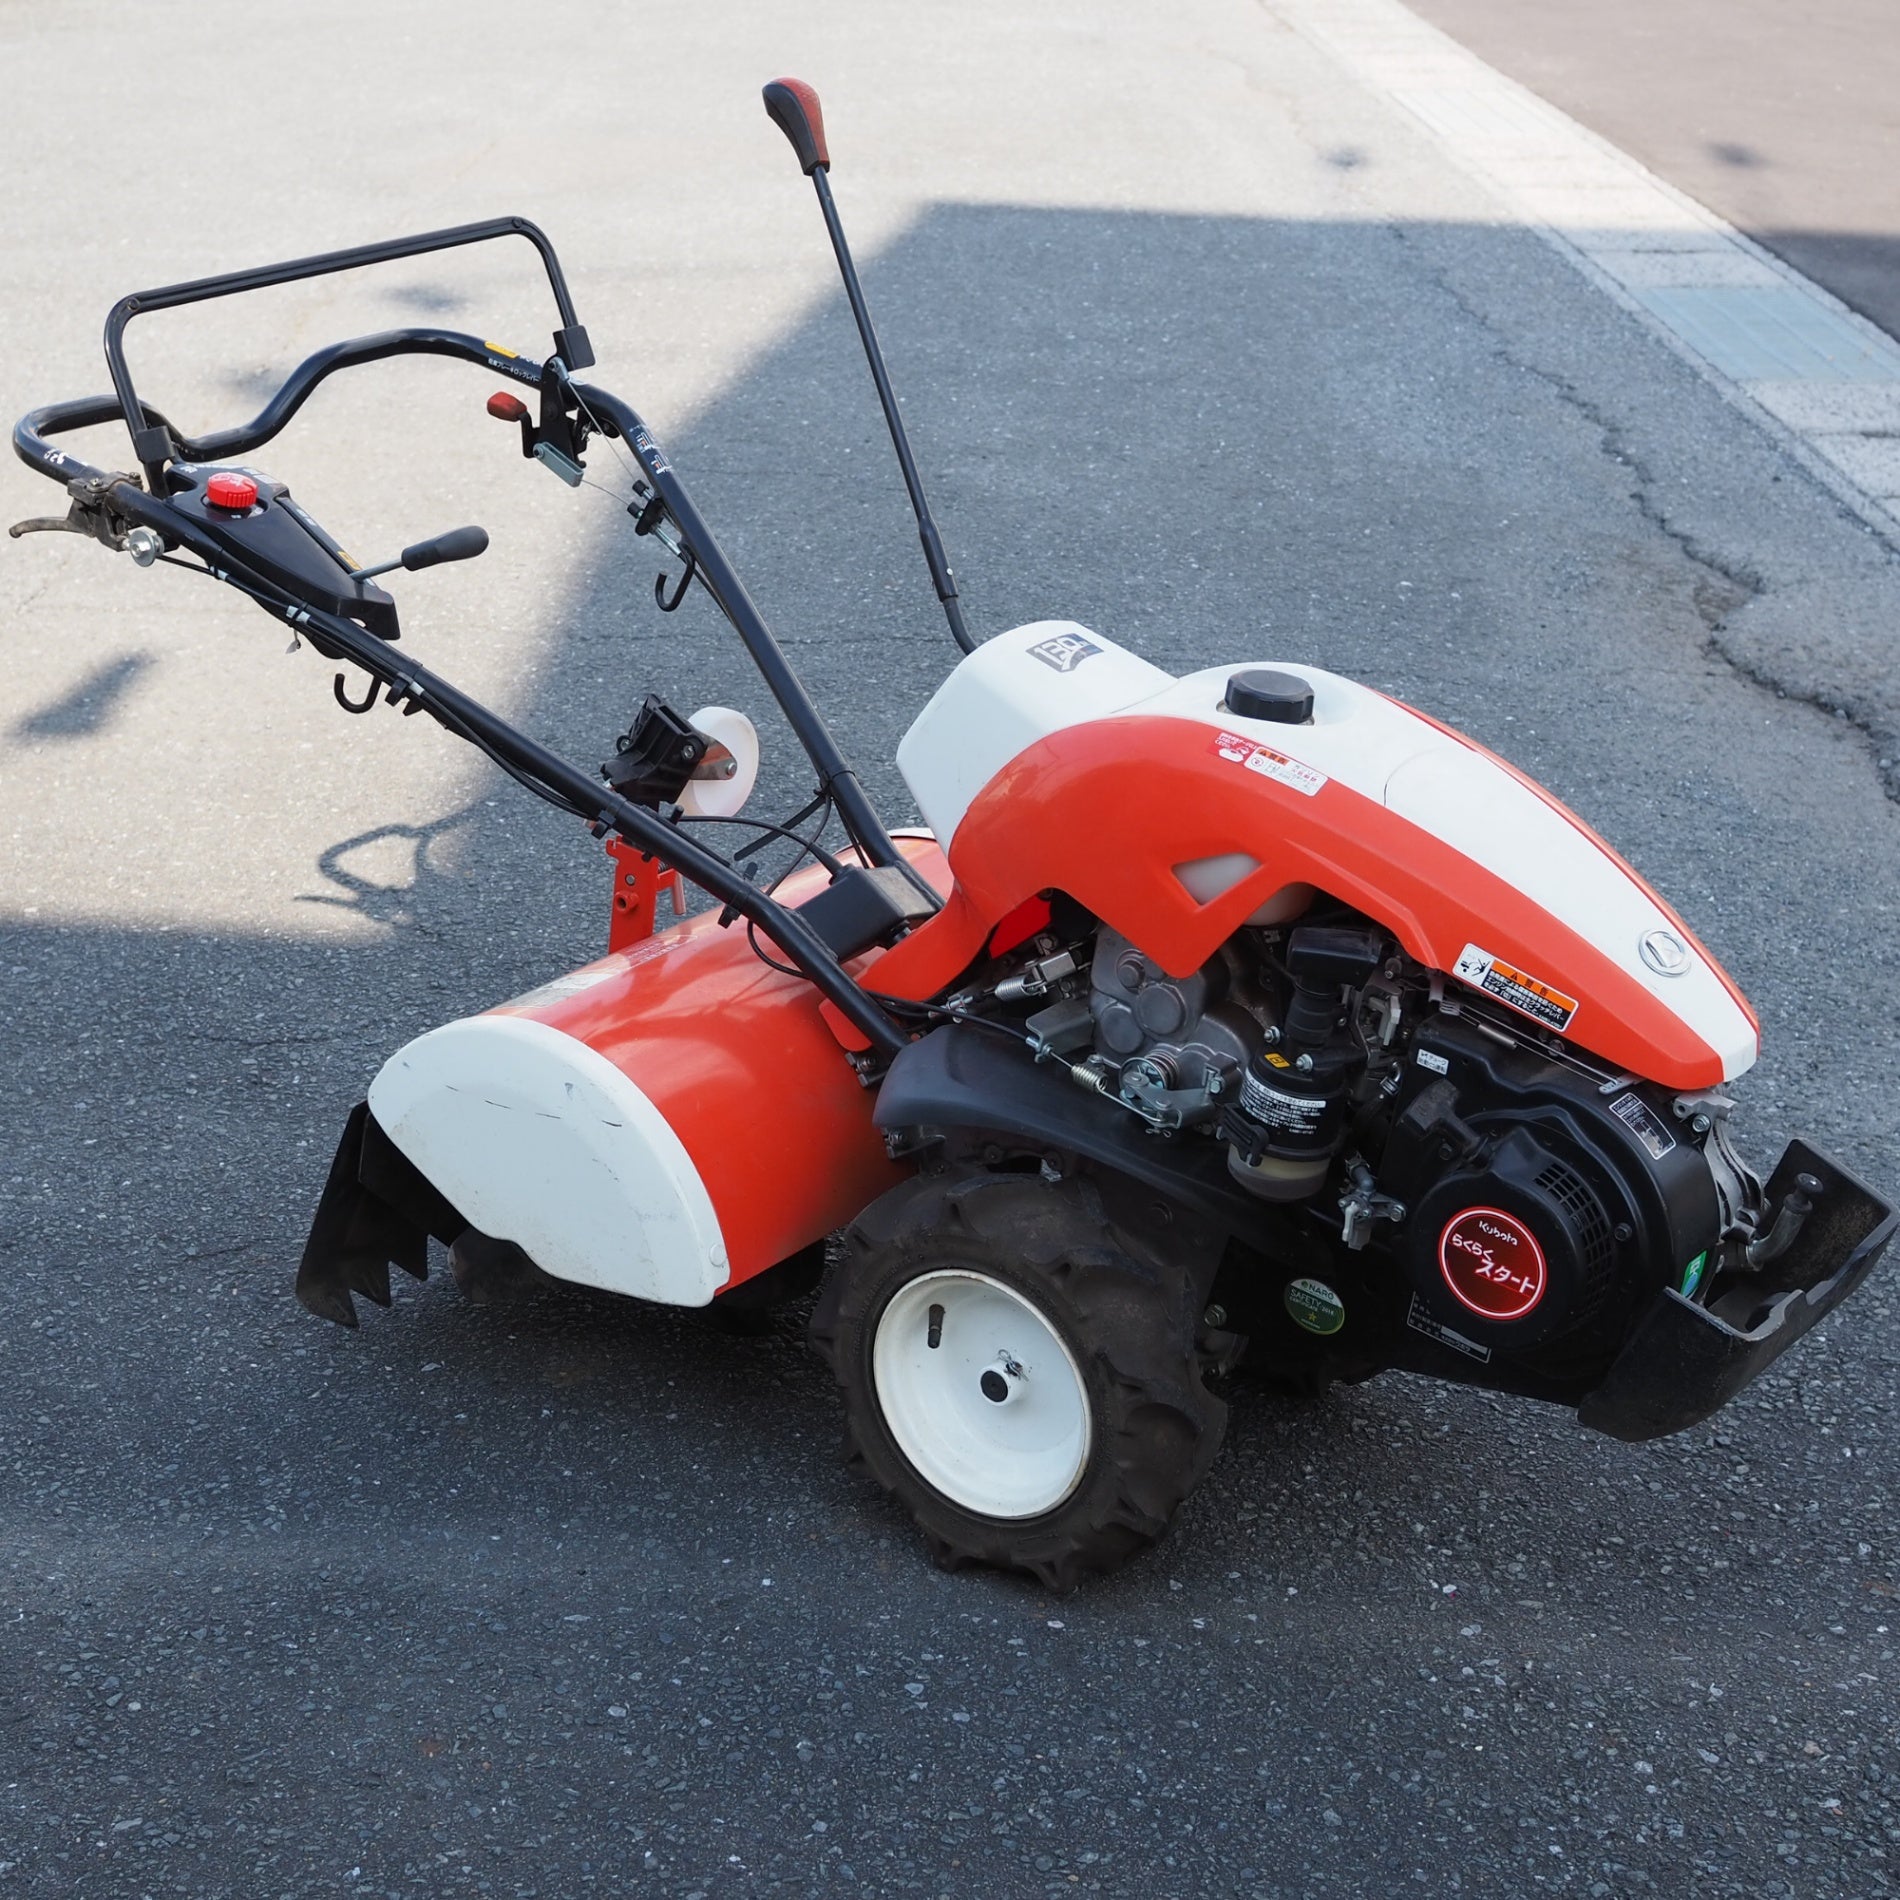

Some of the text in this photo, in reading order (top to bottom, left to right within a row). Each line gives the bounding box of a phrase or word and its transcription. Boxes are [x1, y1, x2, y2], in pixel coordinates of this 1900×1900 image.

[1479, 1220, 1518, 1246] Kubota
[1452, 1233, 1494, 1261] らくらく
[1475, 1259, 1535, 1294] スタート
[1290, 1288, 1322, 1307] SAFETY
[1309, 1283, 1334, 1300] NARO
